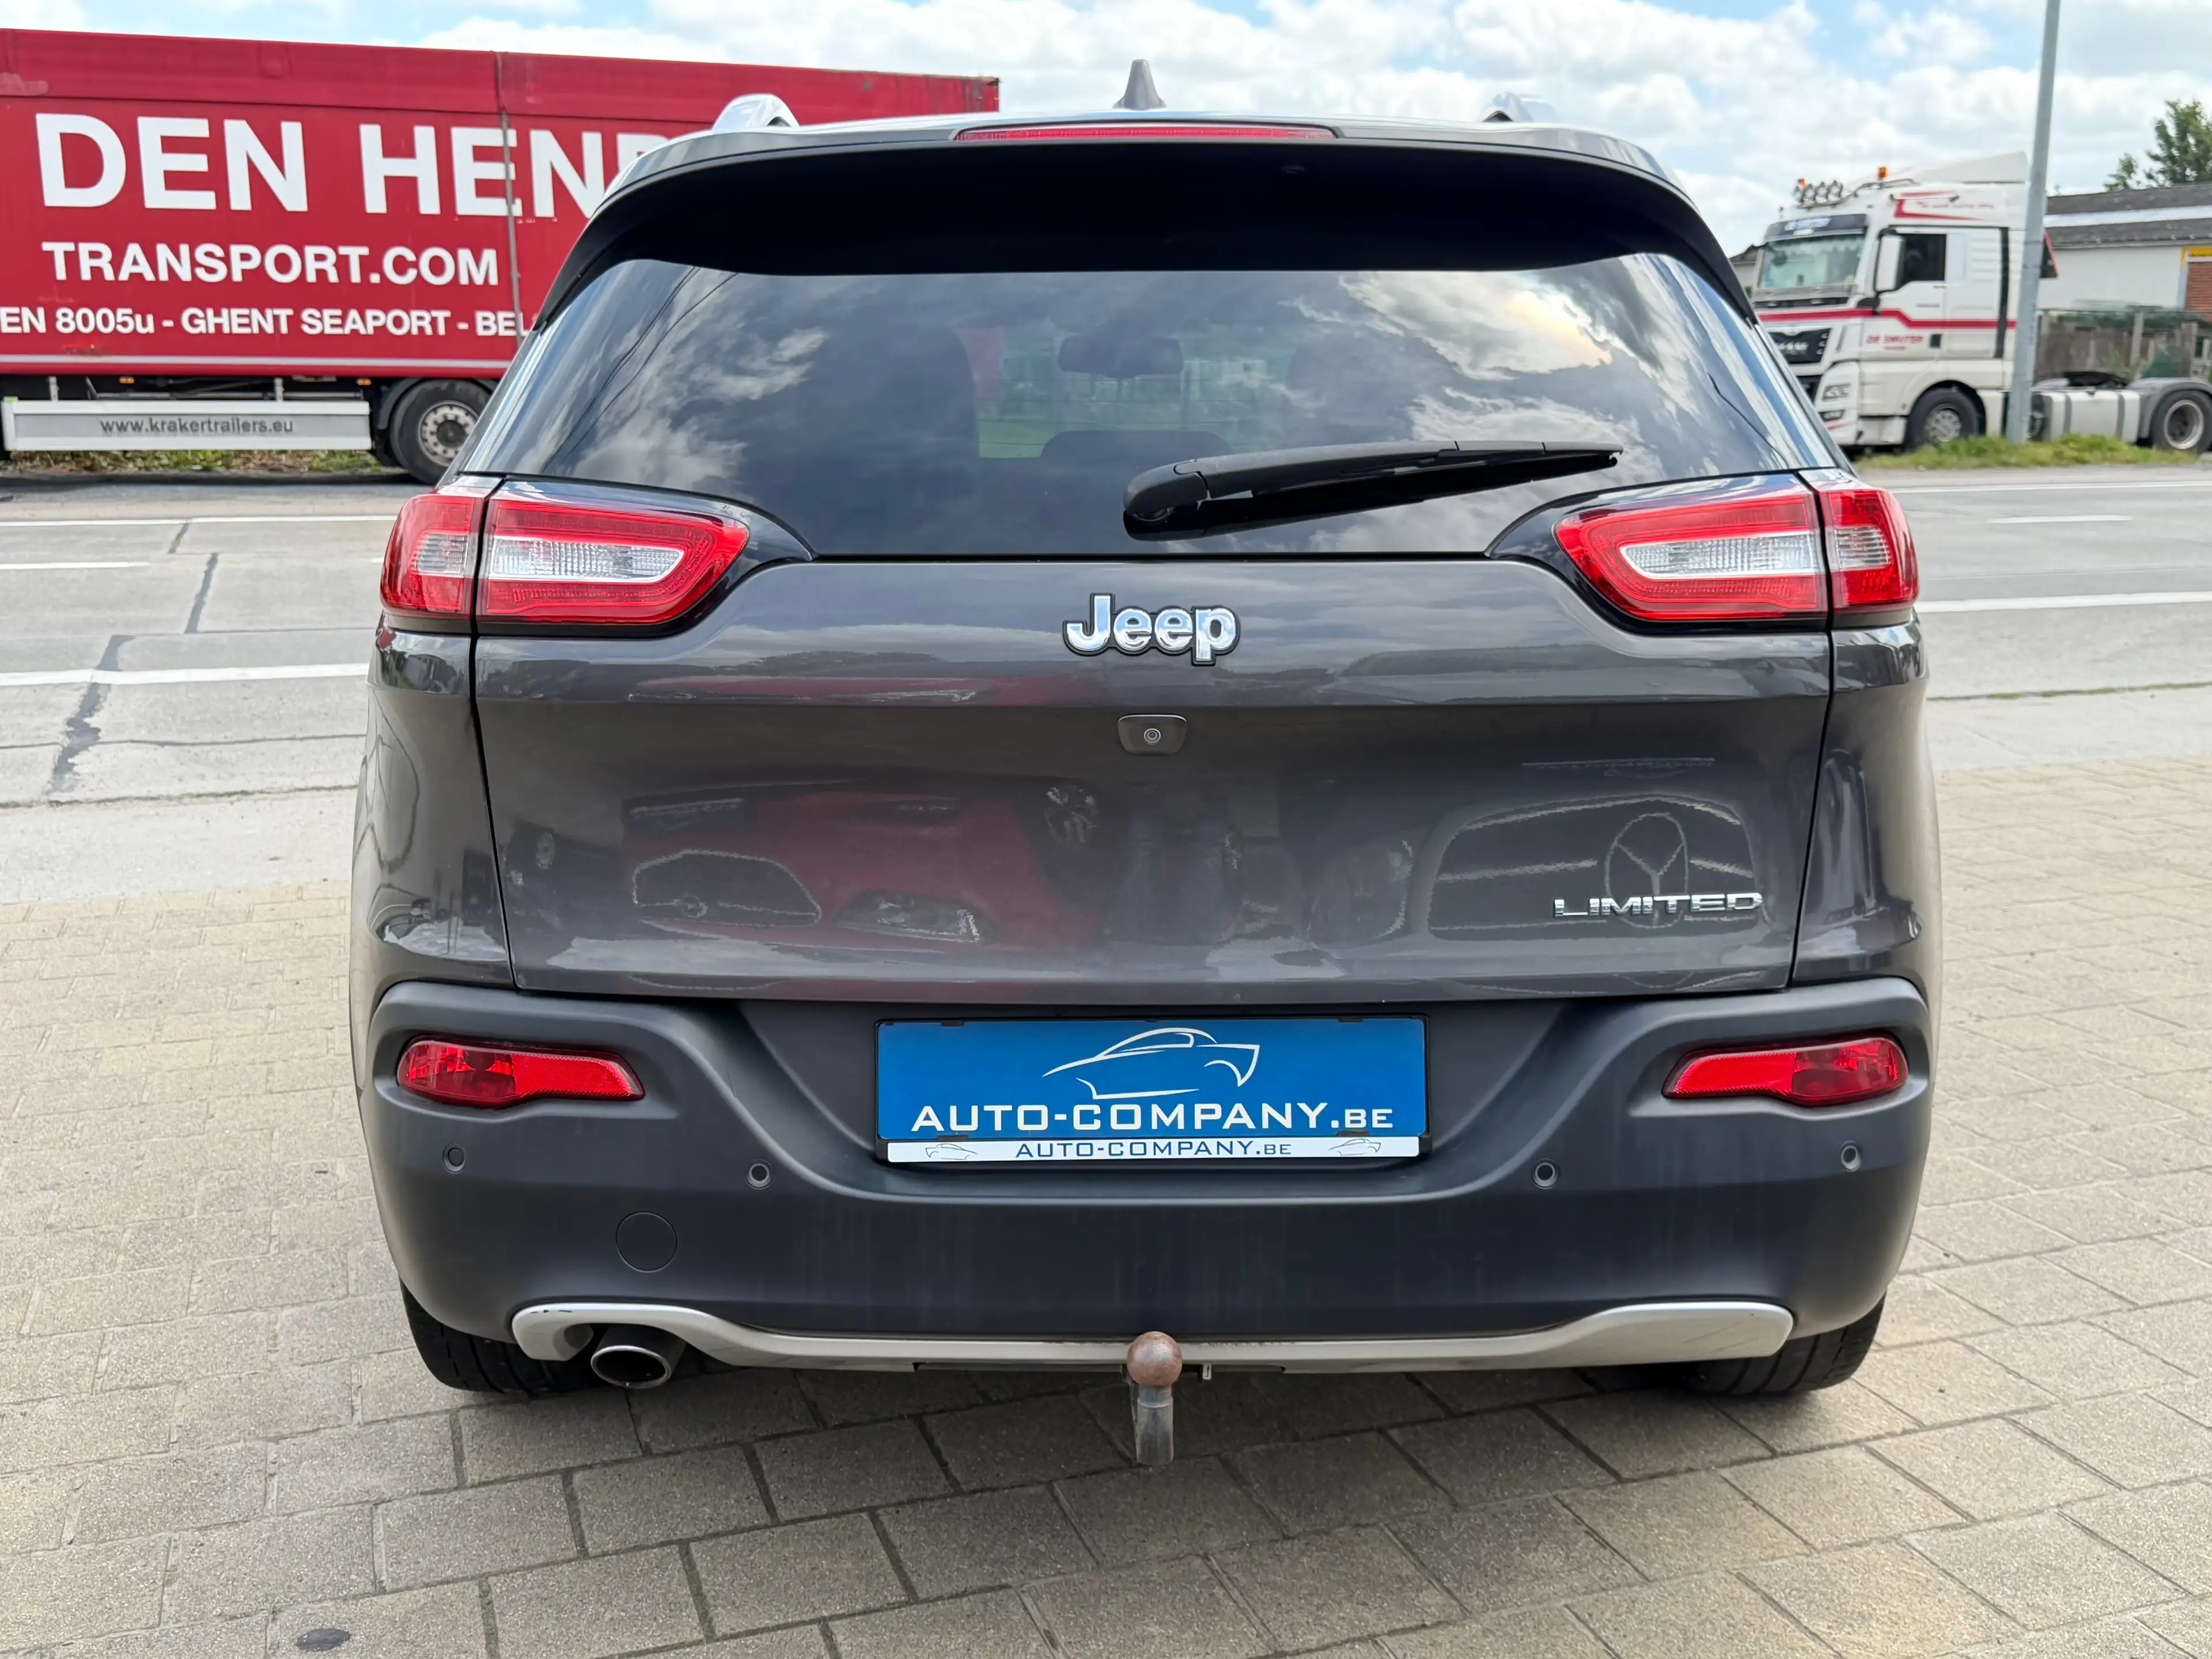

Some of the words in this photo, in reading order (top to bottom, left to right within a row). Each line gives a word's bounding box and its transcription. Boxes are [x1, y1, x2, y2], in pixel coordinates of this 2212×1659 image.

[35, 112, 308, 212] DEN
[41, 241, 499, 286] TRANSPORT.COM
[0, 306, 47, 334] EN
[55, 307, 155, 334] 8005u
[181, 307, 294, 335] GHENT
[300, 308, 452, 336] SEAPORT
[475, 310, 539, 336] BEL
[100, 416, 294, 433] www.krakertrailers.eu
[1066, 594, 1237, 662] Jeep
[1554, 892, 1764, 918] LIMITED
[910, 1101, 1394, 1132] AUTO-COMPANY.BE
[1014, 1140, 1292, 1158] AUTO-COMPANY.BE
